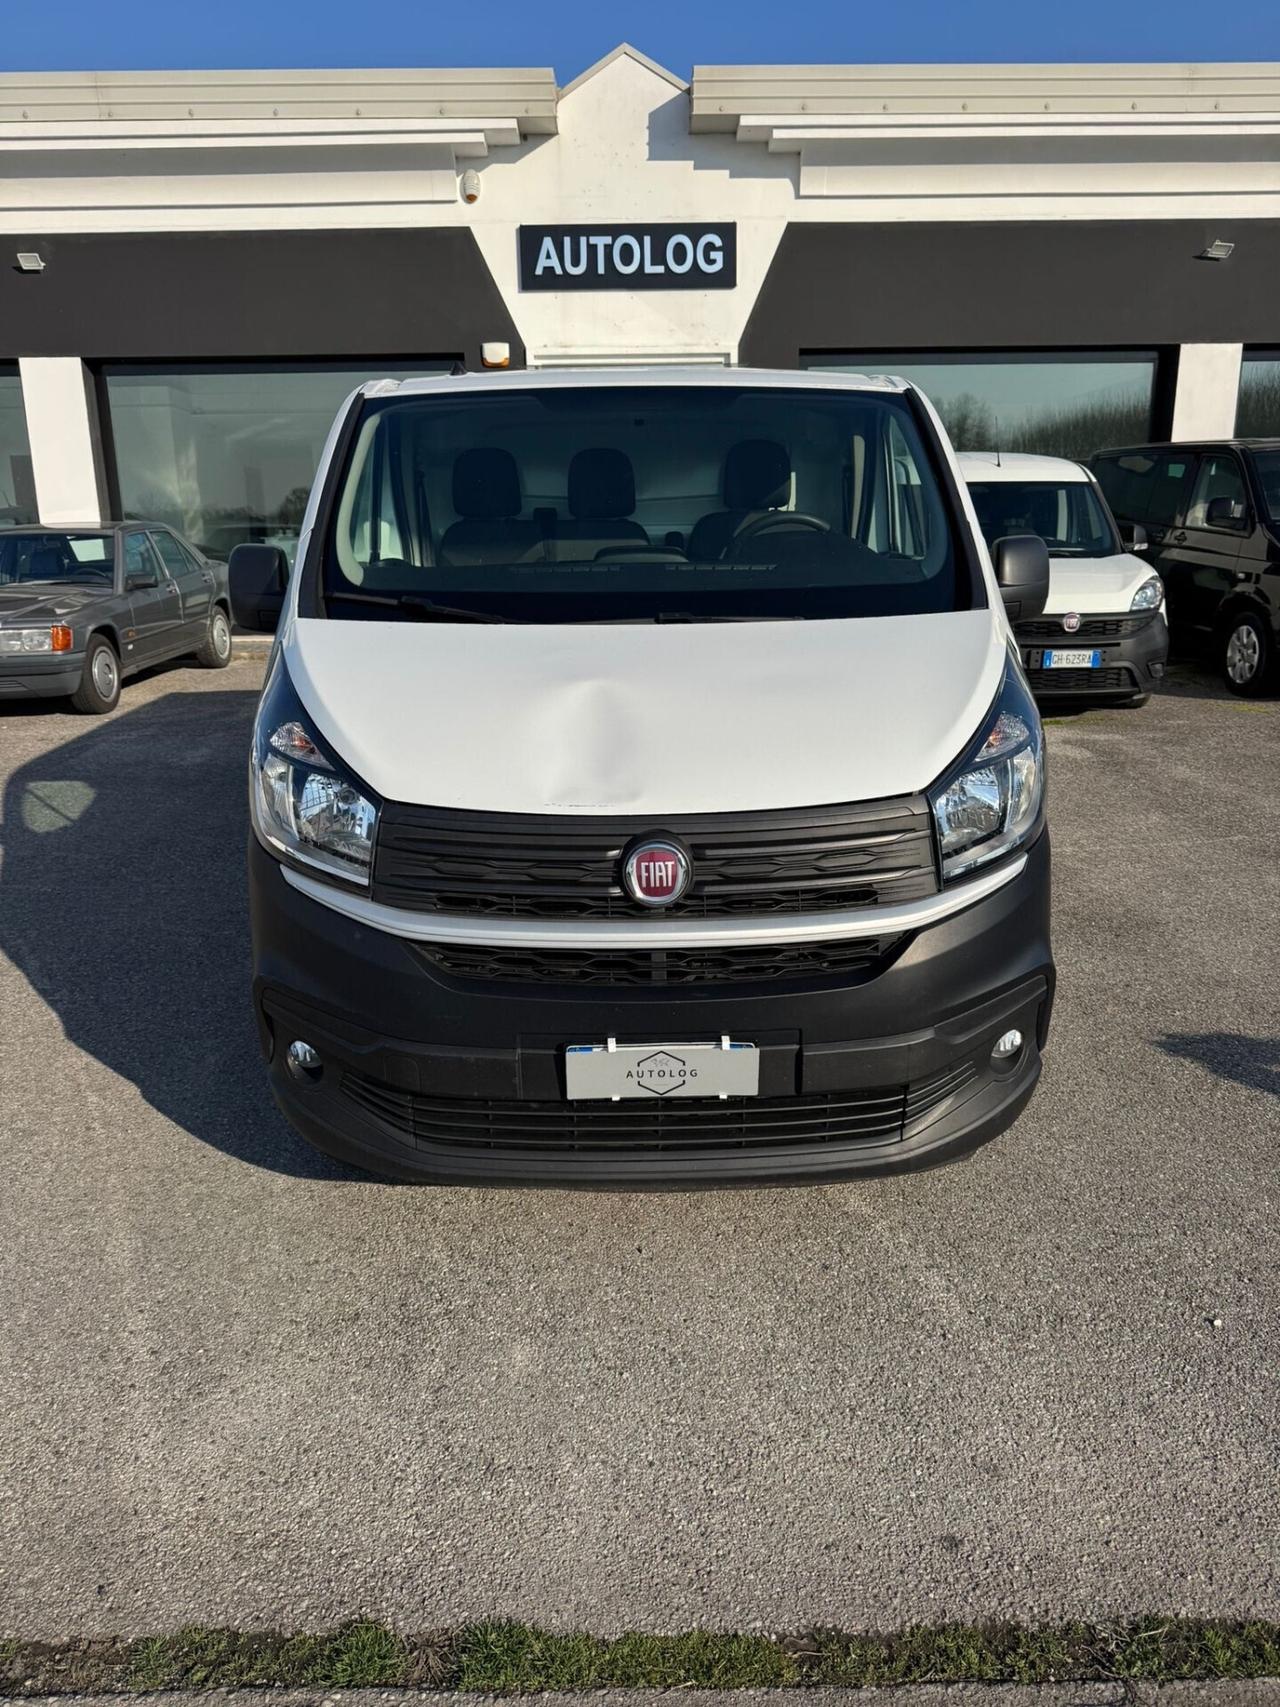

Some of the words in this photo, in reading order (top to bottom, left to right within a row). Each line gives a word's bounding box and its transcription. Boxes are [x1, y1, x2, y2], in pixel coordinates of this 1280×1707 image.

[534, 233, 724, 276] AUTOLOG
[641, 861, 675, 888] FIAT
[626, 1069, 698, 1079] AUTOLOG
